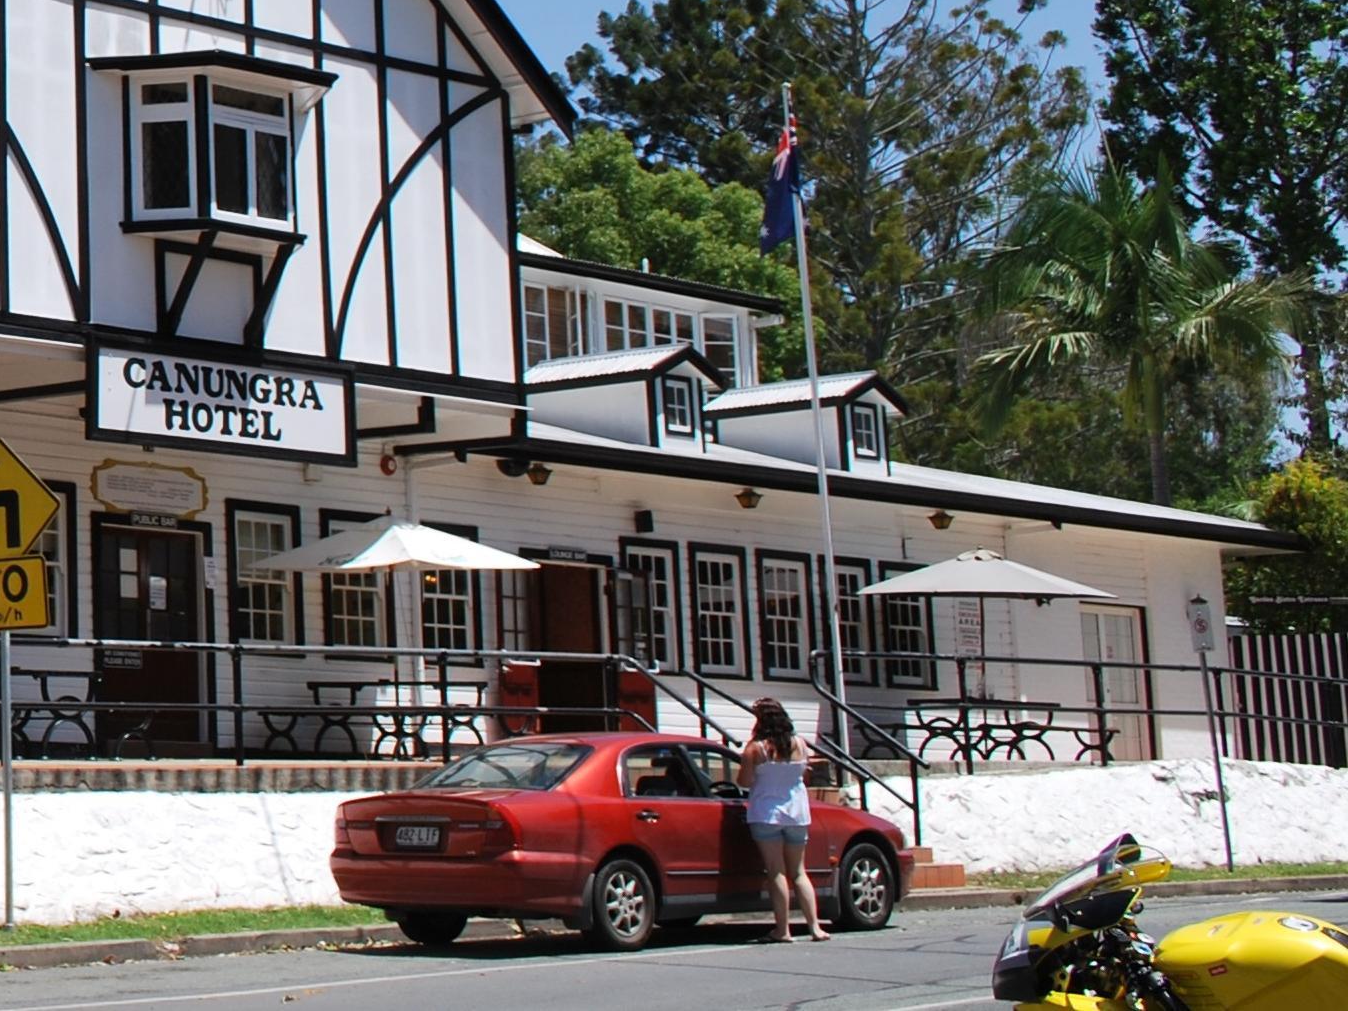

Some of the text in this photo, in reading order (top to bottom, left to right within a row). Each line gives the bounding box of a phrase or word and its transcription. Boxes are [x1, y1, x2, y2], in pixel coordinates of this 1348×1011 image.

[123, 357, 323, 410] CANUNGRA
[162, 397, 282, 441] HOTEL
[132, 514, 177, 528] PUBLIC BAR
